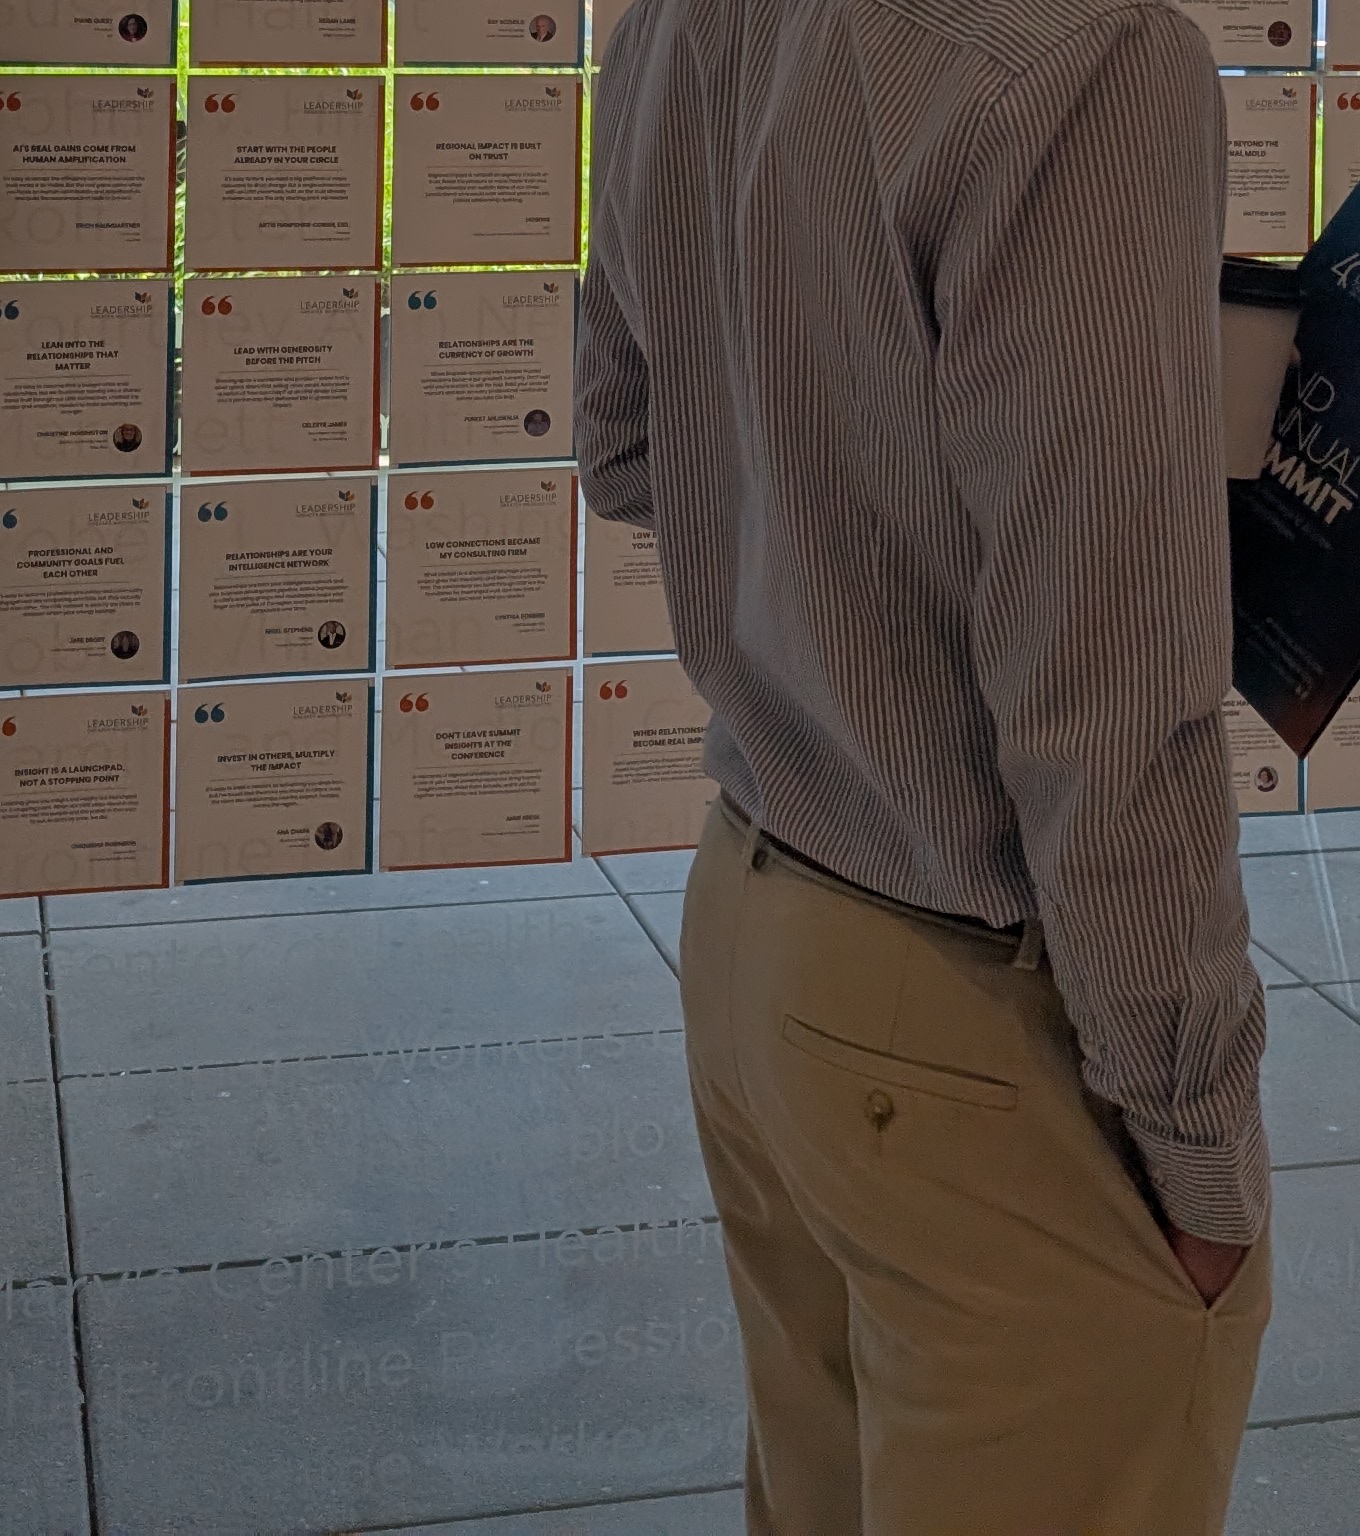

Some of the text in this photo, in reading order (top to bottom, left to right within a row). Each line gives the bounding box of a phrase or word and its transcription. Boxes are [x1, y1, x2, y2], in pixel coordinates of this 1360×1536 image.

[236, 145, 336, 153] START WITH THE PEOPLE
[234, 155, 272, 164] ALREADY
[284, 155, 308, 164] YOUR
[309, 155, 339, 164] CIRCLE
[233, 344, 332, 354] LEAD WITH GENEROSITY
[438, 338, 534, 348] RELATIONSHIPS ARE THE
[438, 349, 482, 358] CURRENCY
[496, 349, 533, 357] GROWTH
[245, 355, 321, 365] BEFORE THE PITCH
[1266, 440, 1355, 524] MMIT
[27, 546, 113, 557] PROFESSIONAL AND
[224, 547, 333, 560] RELATIONSHIPS ARE YOUR
[15, 556, 124, 569] COMMUNITY GOALS FUEL
[228, 558, 329, 571] INTELLIGENCE NETWORK
[42, 568, 98, 578] EACH OTHER
[13, 766, 49, 776] INSIGHT
[68, 763, 125, 775] LAUNCHPAD,
[18, 778, 38, 787] NOT
[47, 775, 91, 785] STOPPING
[92, 774, 119, 783] POINT
[208, 1238, 479, 1302] Center's
[115, 1339, 412, 1420] Frontline
[442, 1312, 732, 1384] Professio
